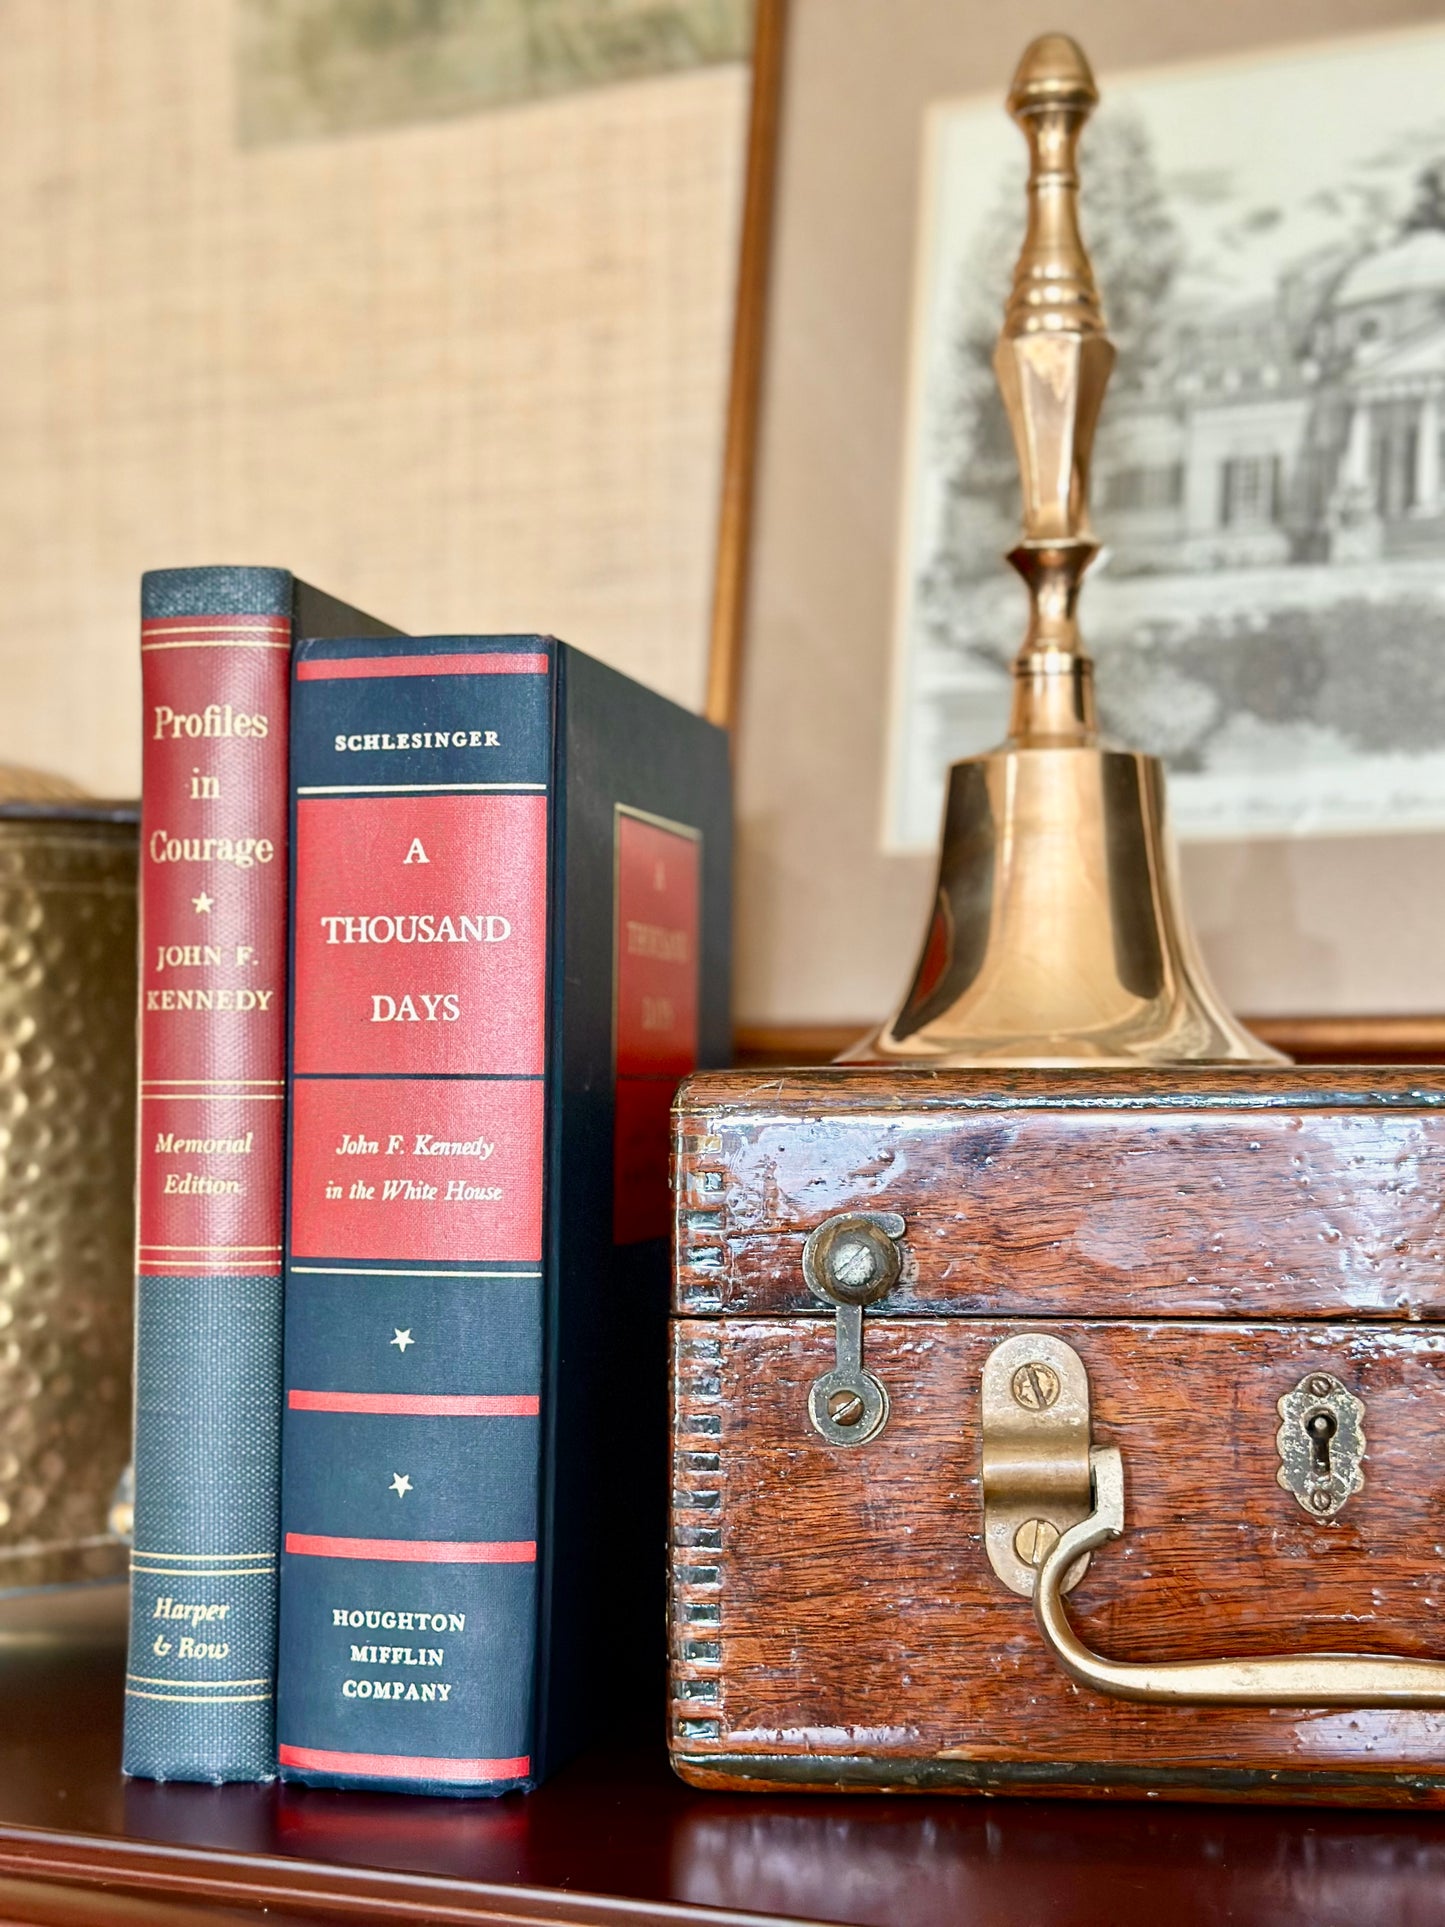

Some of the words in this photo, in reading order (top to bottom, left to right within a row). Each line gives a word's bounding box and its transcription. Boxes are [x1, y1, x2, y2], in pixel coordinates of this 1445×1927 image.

[153, 705, 269, 740] Profiles
[335, 731, 501, 751] SCHLESINGER
[190, 767, 221, 800] in
[150, 830, 274, 869] Courage
[403, 838, 430, 865] A
[321, 916, 511, 943] THOUSAND
[156, 945, 222, 972] JOHN
[236, 946, 260, 967] F.
[146, 990, 273, 1012] KENNEDY
[371, 995, 460, 1022] DAYS
[155, 1133, 253, 1155] Memorial
[335, 1134, 380, 1155] John
[386, 1135, 406, 1156] F.
[412, 1136, 495, 1160] Kennedy
[164, 1174, 241, 1196] Edition
[325, 1180, 343, 1201] in
[348, 1180, 376, 1201] the
[381, 1180, 438, 1202] White
[444, 1180, 503, 1202] House
[153, 1597, 230, 1628] Harper
[333, 1609, 466, 1632] HOUGHTON
[152, 1636, 172, 1658] &
[178, 1637, 230, 1660] Row
[350, 1645, 445, 1666] MIFFLIN
[343, 1680, 452, 1702] COMPANY
